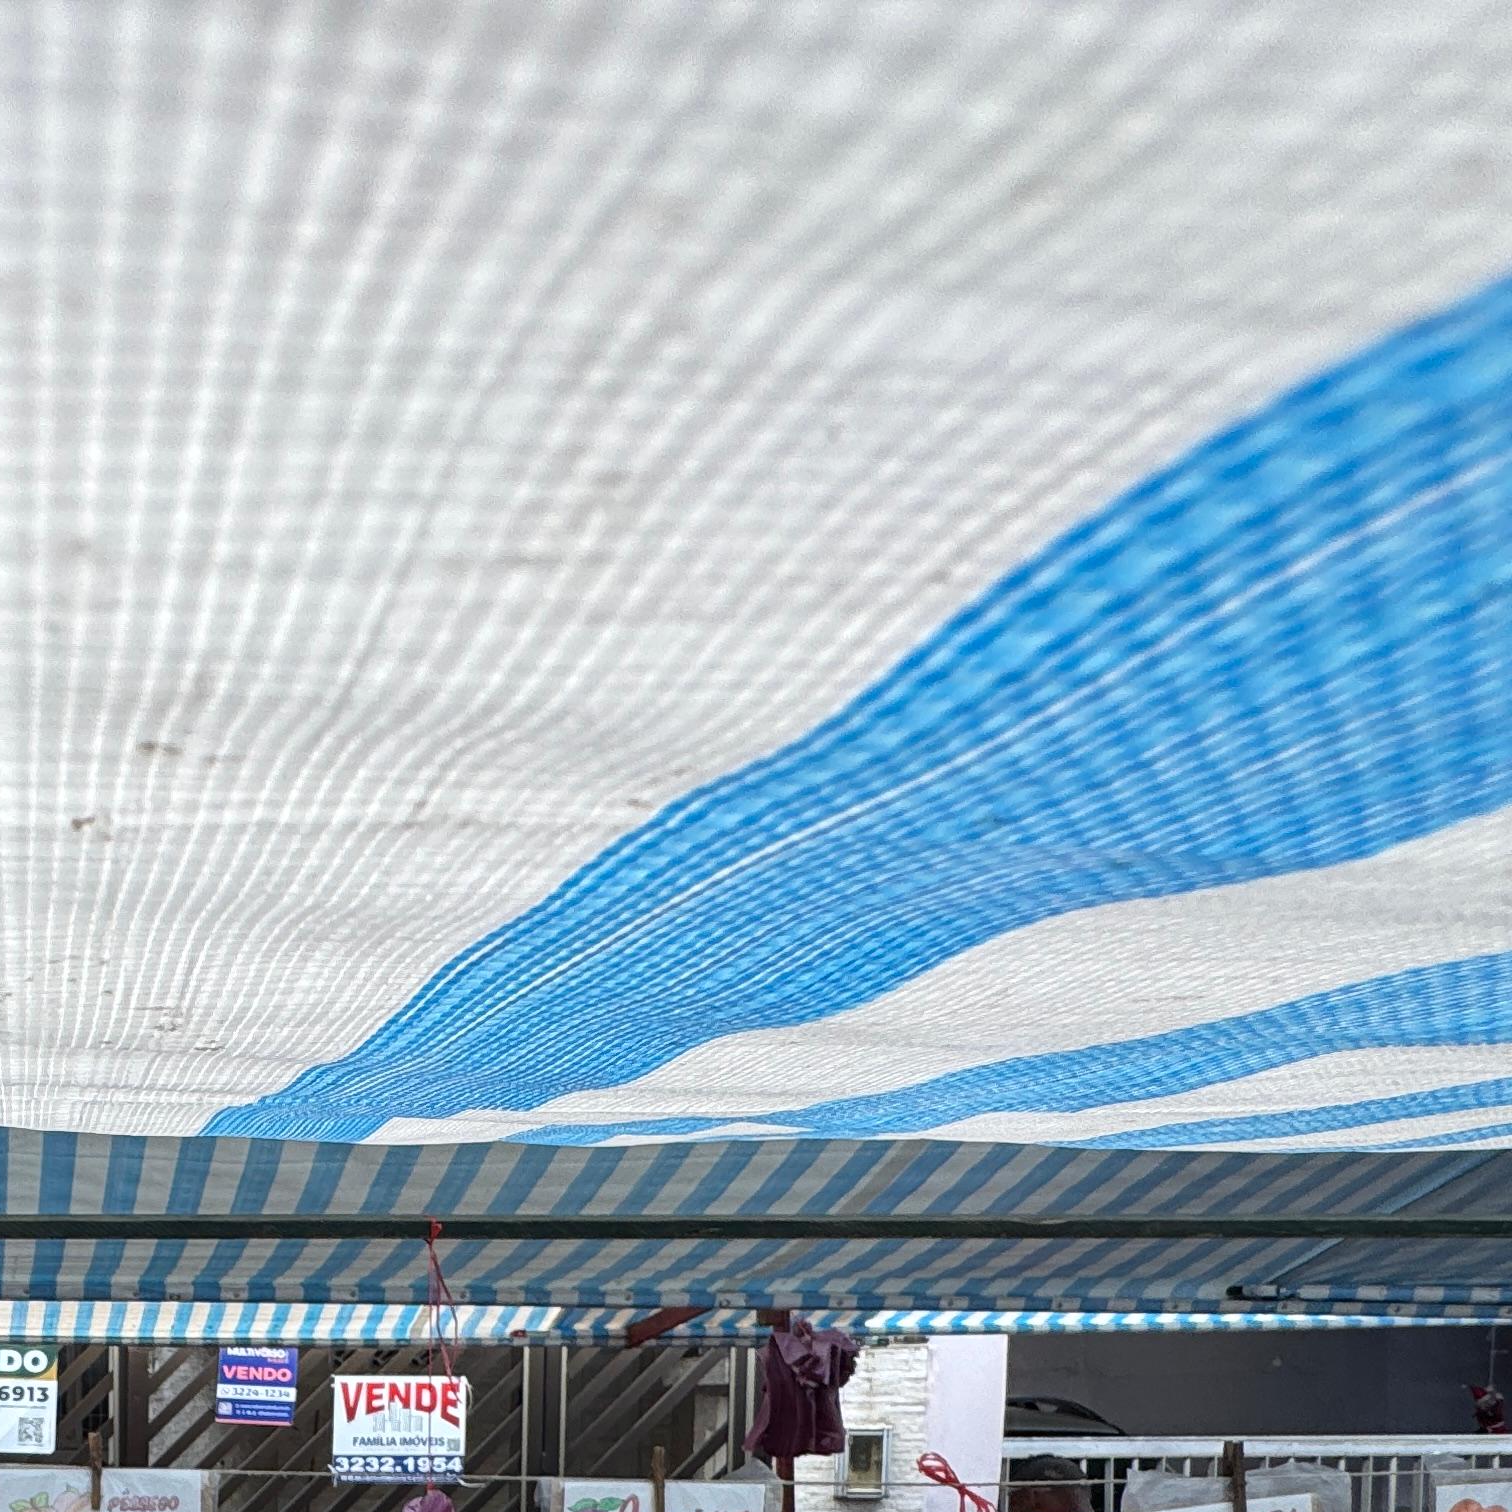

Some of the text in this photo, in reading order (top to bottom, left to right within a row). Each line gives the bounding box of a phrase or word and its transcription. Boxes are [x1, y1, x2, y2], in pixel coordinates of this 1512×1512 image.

[223, 1365, 292, 1382] VENDO
[340, 1382, 460, 1428] VENDE
[335, 1457, 463, 1473] 3232.1954
